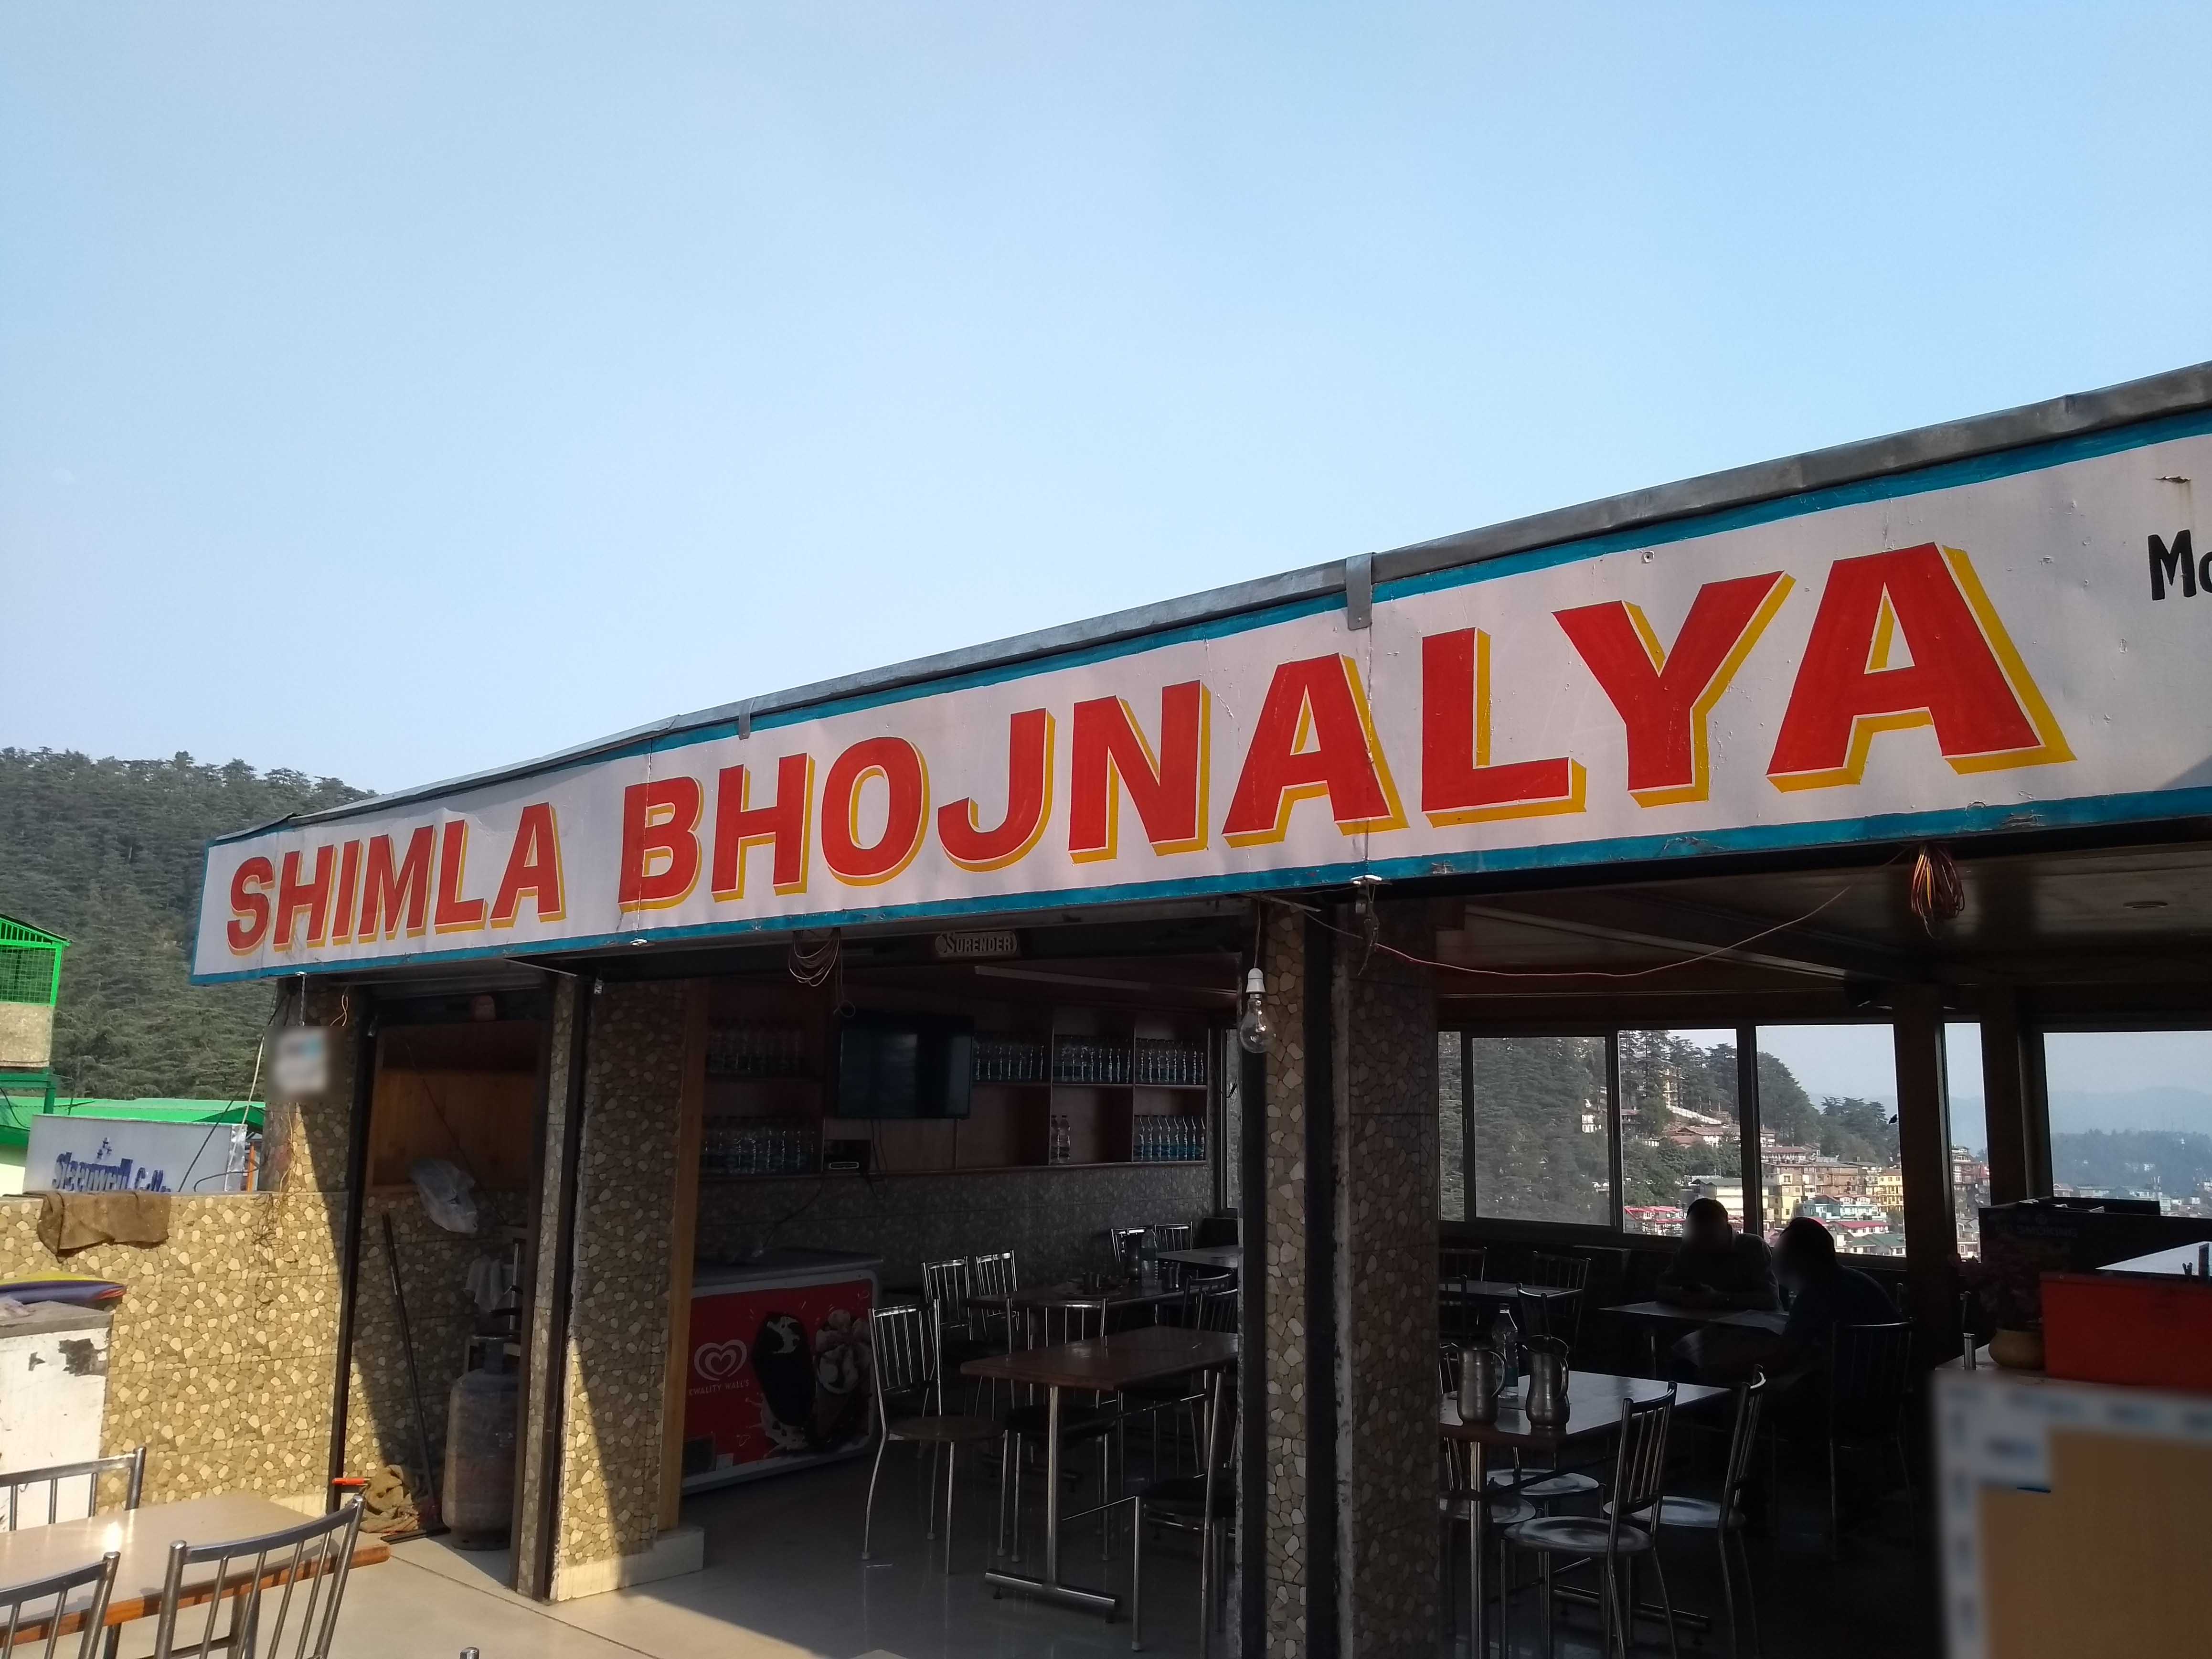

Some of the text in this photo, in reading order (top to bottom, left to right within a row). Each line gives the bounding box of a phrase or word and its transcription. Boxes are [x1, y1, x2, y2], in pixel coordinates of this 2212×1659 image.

[226, 542, 2077, 956] SHIMLA BHOJNALYA
[724, 1379, 749, 1390] WALL'S
